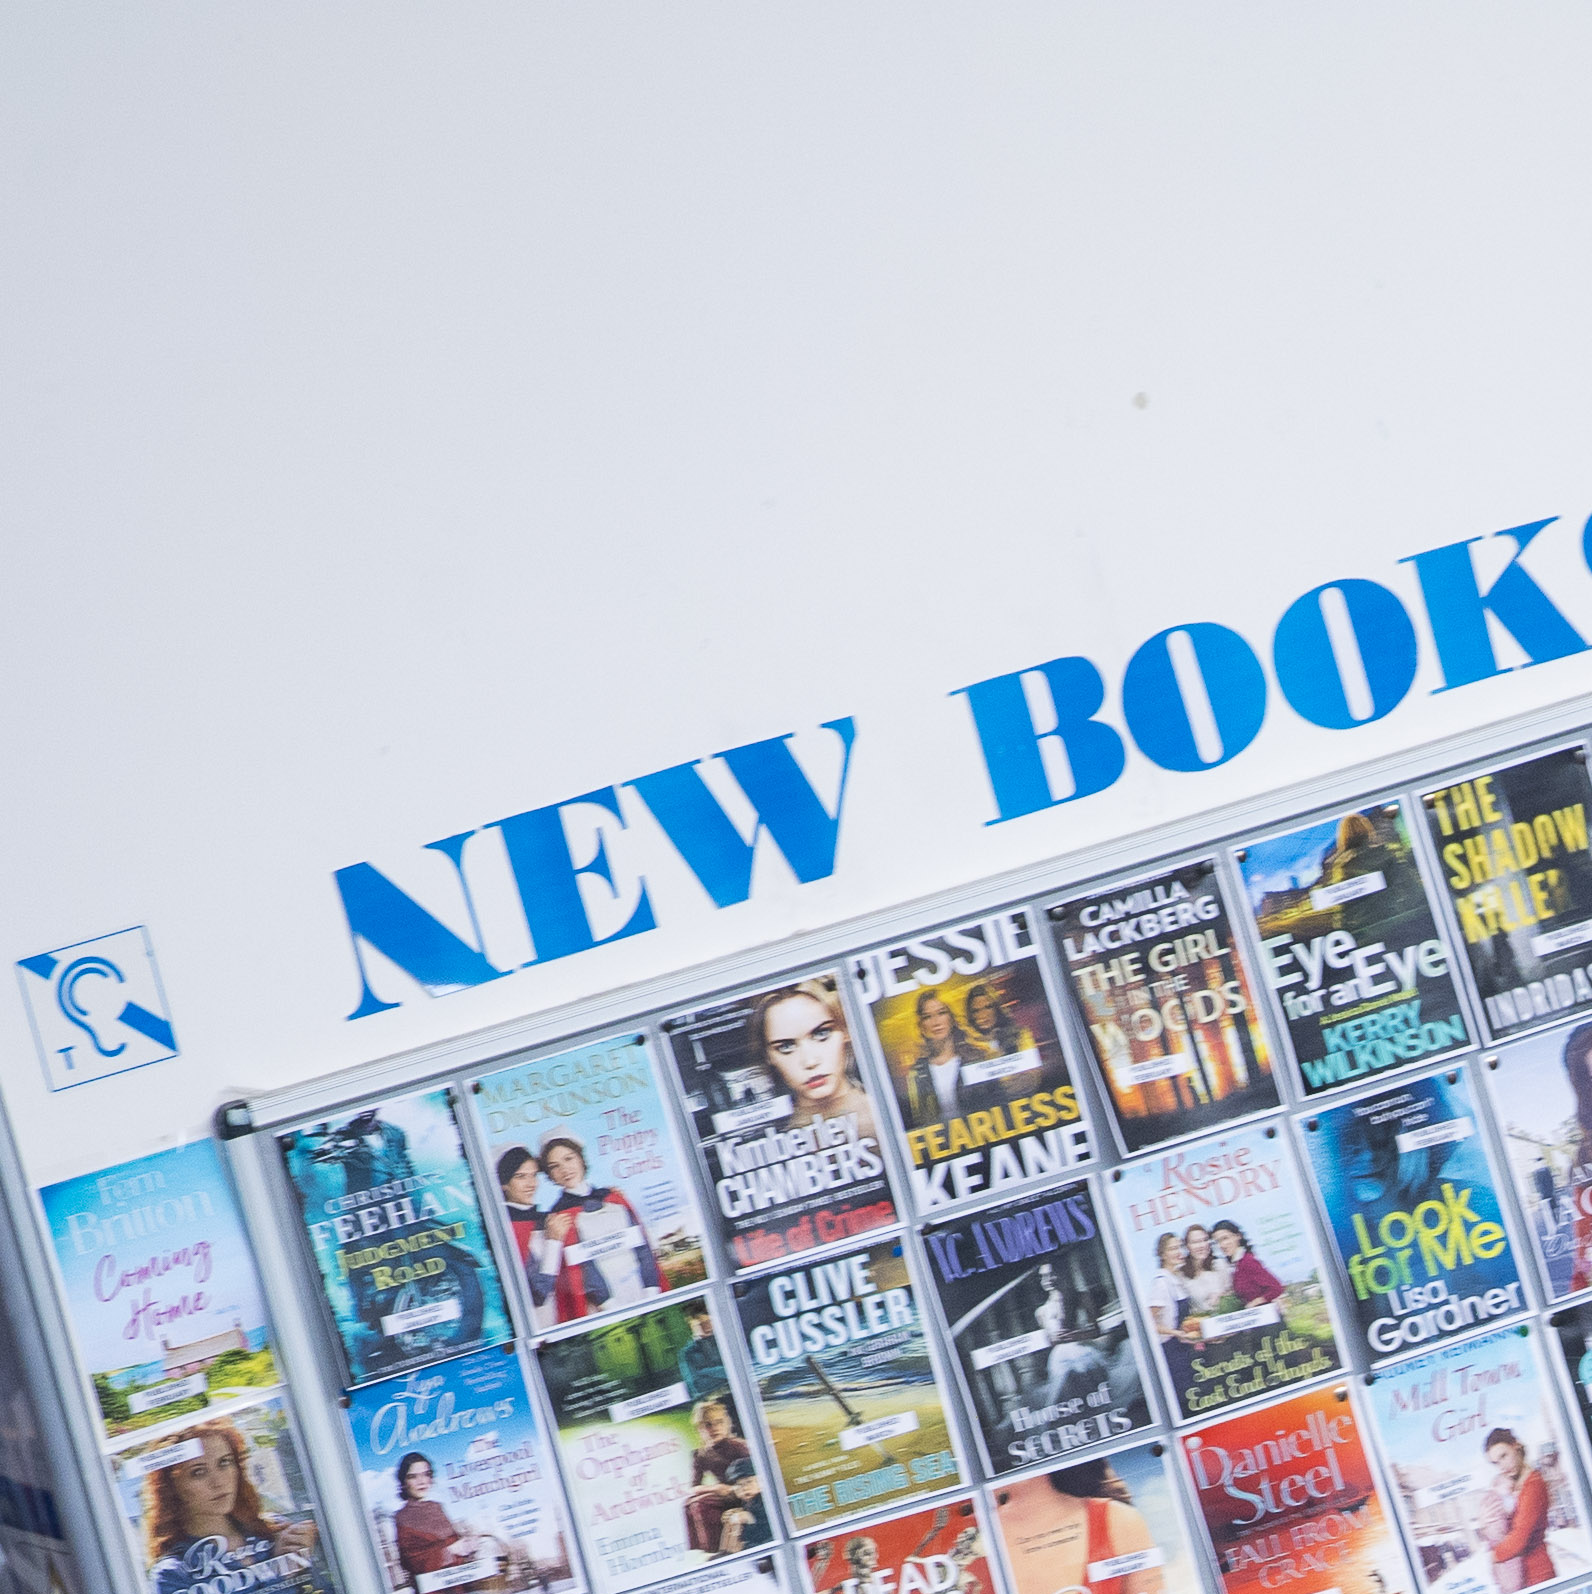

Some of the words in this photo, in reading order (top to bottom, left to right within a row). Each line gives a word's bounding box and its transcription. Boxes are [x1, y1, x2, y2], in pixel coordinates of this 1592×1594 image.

[1438, 774, 1502, 836] THE
[335, 717, 855, 1024] NEW
[1443, 803, 1589, 890] SHADOW
[1062, 895, 1221, 961] LACKBERG
[1078, 880, 1193, 928] CAMILLA
[850, 907, 1038, 1005] JESSIE
[1073, 951, 1146, 994] THE
[1148, 929, 1232, 973] GIRL
[1258, 929, 1357, 990] Eye
[1284, 989, 1327, 1021] for
[1353, 938, 1450, 1001] Eye
[1091, 981, 1248, 1065] WOODS
[1301, 1015, 1467, 1089] WILKINSON
[1322, 1000, 1422, 1055] KERRY
[480, 1044, 641, 1107] MARGARET
[486, 1067, 650, 1134] DICKINSON
[597, 1125, 658, 1158] Poppy
[602, 1106, 641, 1134] The
[714, 1111, 862, 1178] Kimberley
[905, 1085, 1081, 1165] FEARLESS
[612, 1152, 665, 1180] Girls
[714, 1137, 885, 1219] CHAMBERS
[912, 1121, 1097, 1214] KEANE
[1129, 1159, 1285, 1234] HENDRY
[1158, 1143, 1253, 1192] Rosie
[64, 1186, 214, 1256] Britton
[308, 1184, 480, 1250] FEEHAN
[733, 1227, 789, 1266] Life
[814, 1200, 898, 1242] Crime
[1353, 1183, 1482, 1259] Look
[93, 1239, 214, 1303] Coming
[337, 1221, 468, 1280] JUDGMENT
[369, 1256, 447, 1292] ROAD
[1348, 1249, 1413, 1301] for
[1417, 1220, 1507, 1278] Me
[122, 1289, 212, 1342] Home
[768, 1253, 877, 1319] CLIVE
[1367, 1279, 1522, 1354] Gardner
[1389, 1279, 1448, 1319] Lisa
[750, 1286, 916, 1367] CUSSLER
[576, 1434, 682, 1481] Orphans
[582, 1430, 620, 1453] The
[1007, 1406, 1133, 1467] SECRETS
[1186, 1410, 1353, 1491] Danielle
[591, 1480, 687, 1527] Ardwick
[787, 1486, 833, 1519] THE
[835, 1464, 908, 1506] RISING
[911, 1449, 959, 1485] SEA
[1223, 1447, 1346, 1527] Steel
[1223, 1533, 1292, 1574] FALL
[1258, 1539, 1352, 1590] GRACE
